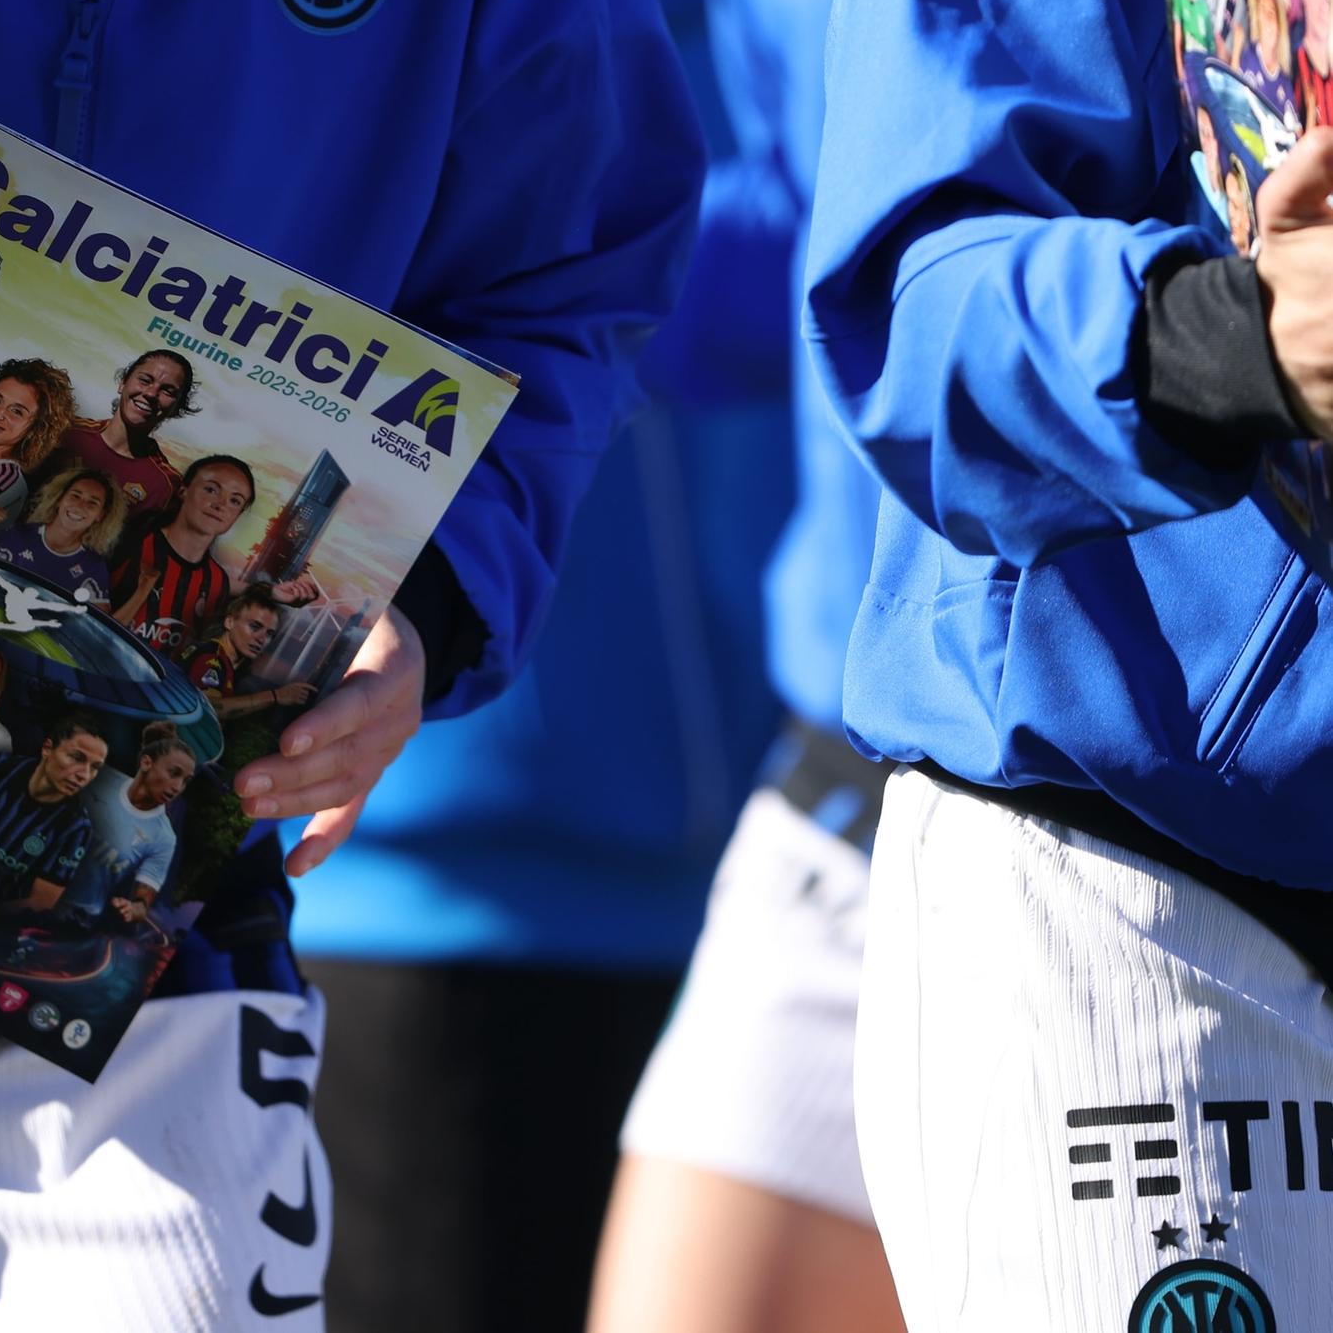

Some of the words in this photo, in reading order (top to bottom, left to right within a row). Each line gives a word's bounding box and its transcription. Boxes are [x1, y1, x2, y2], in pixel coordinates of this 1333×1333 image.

[146, 316, 244, 371] Figurine
[246, 364, 351, 423] 2025-2026
[371, 434, 430, 472] WOMEN
[377, 426, 420, 454] SERIE
[419, 451, 431, 462] A
